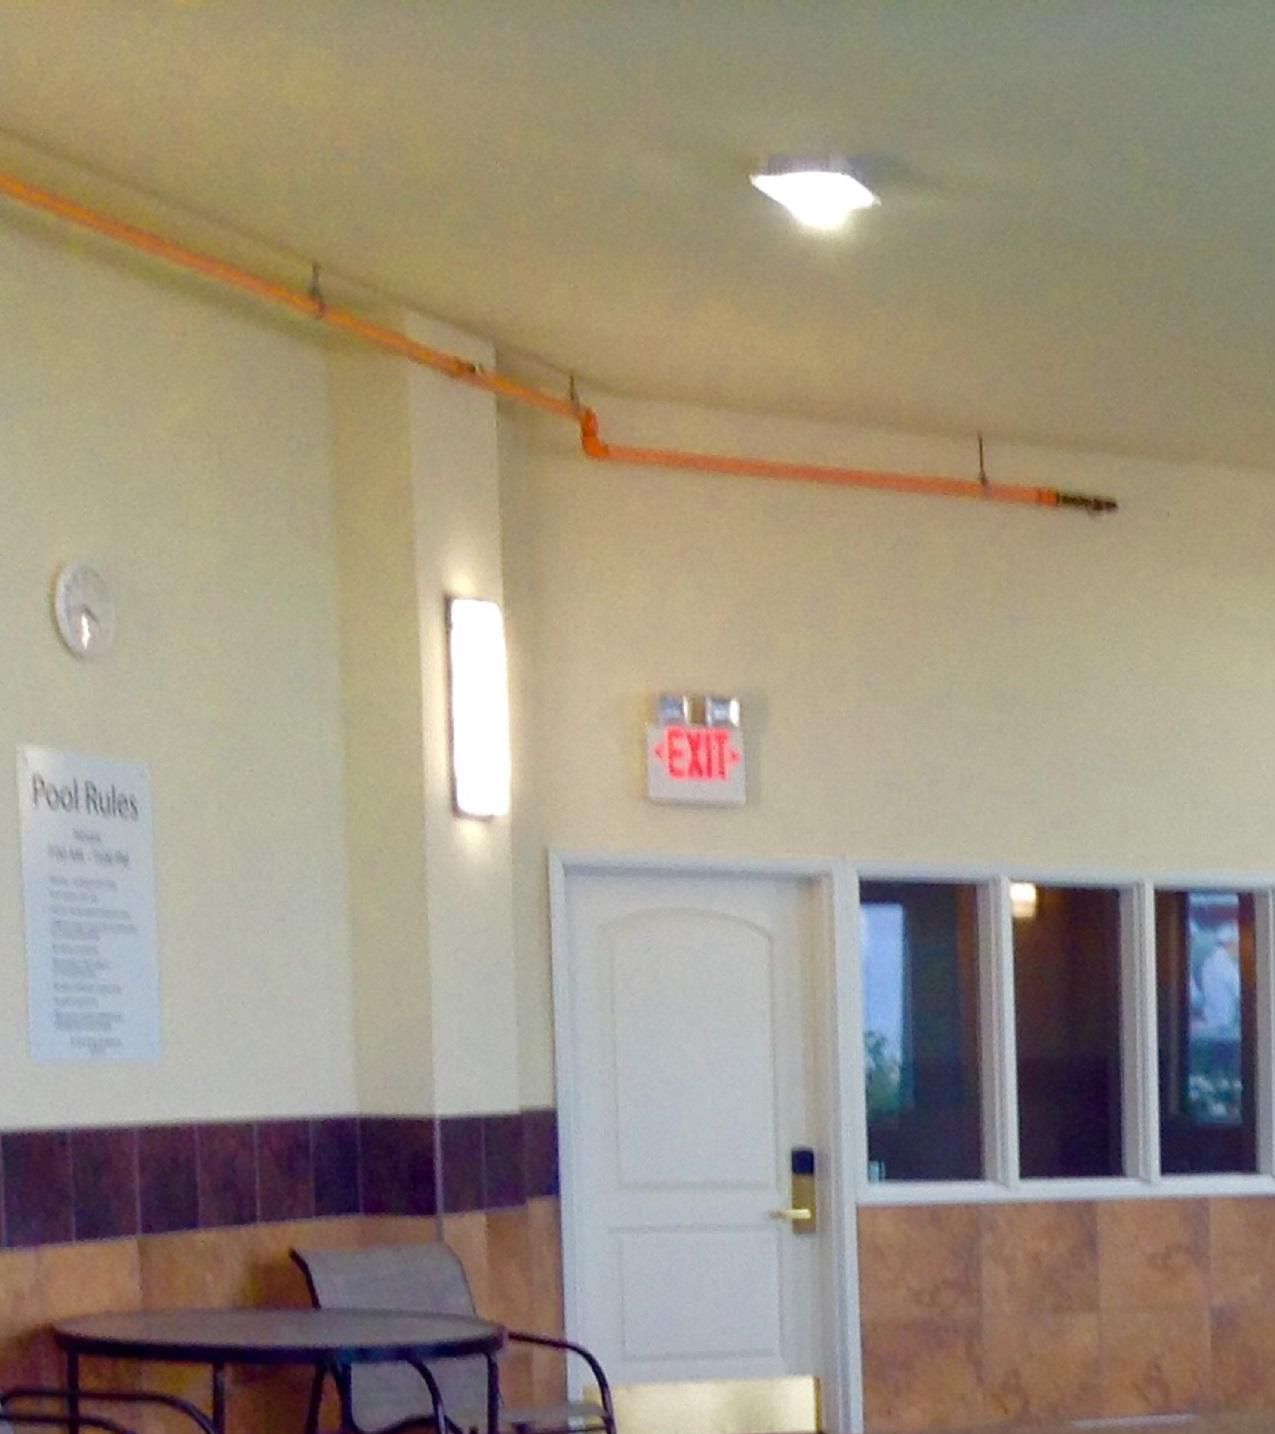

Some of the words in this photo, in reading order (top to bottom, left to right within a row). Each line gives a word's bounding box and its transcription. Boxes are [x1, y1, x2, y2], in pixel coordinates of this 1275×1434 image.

[666, 727, 729, 780] EXIT
[32, 772, 79, 812] Pool
[84, 780, 139, 821] Rules
